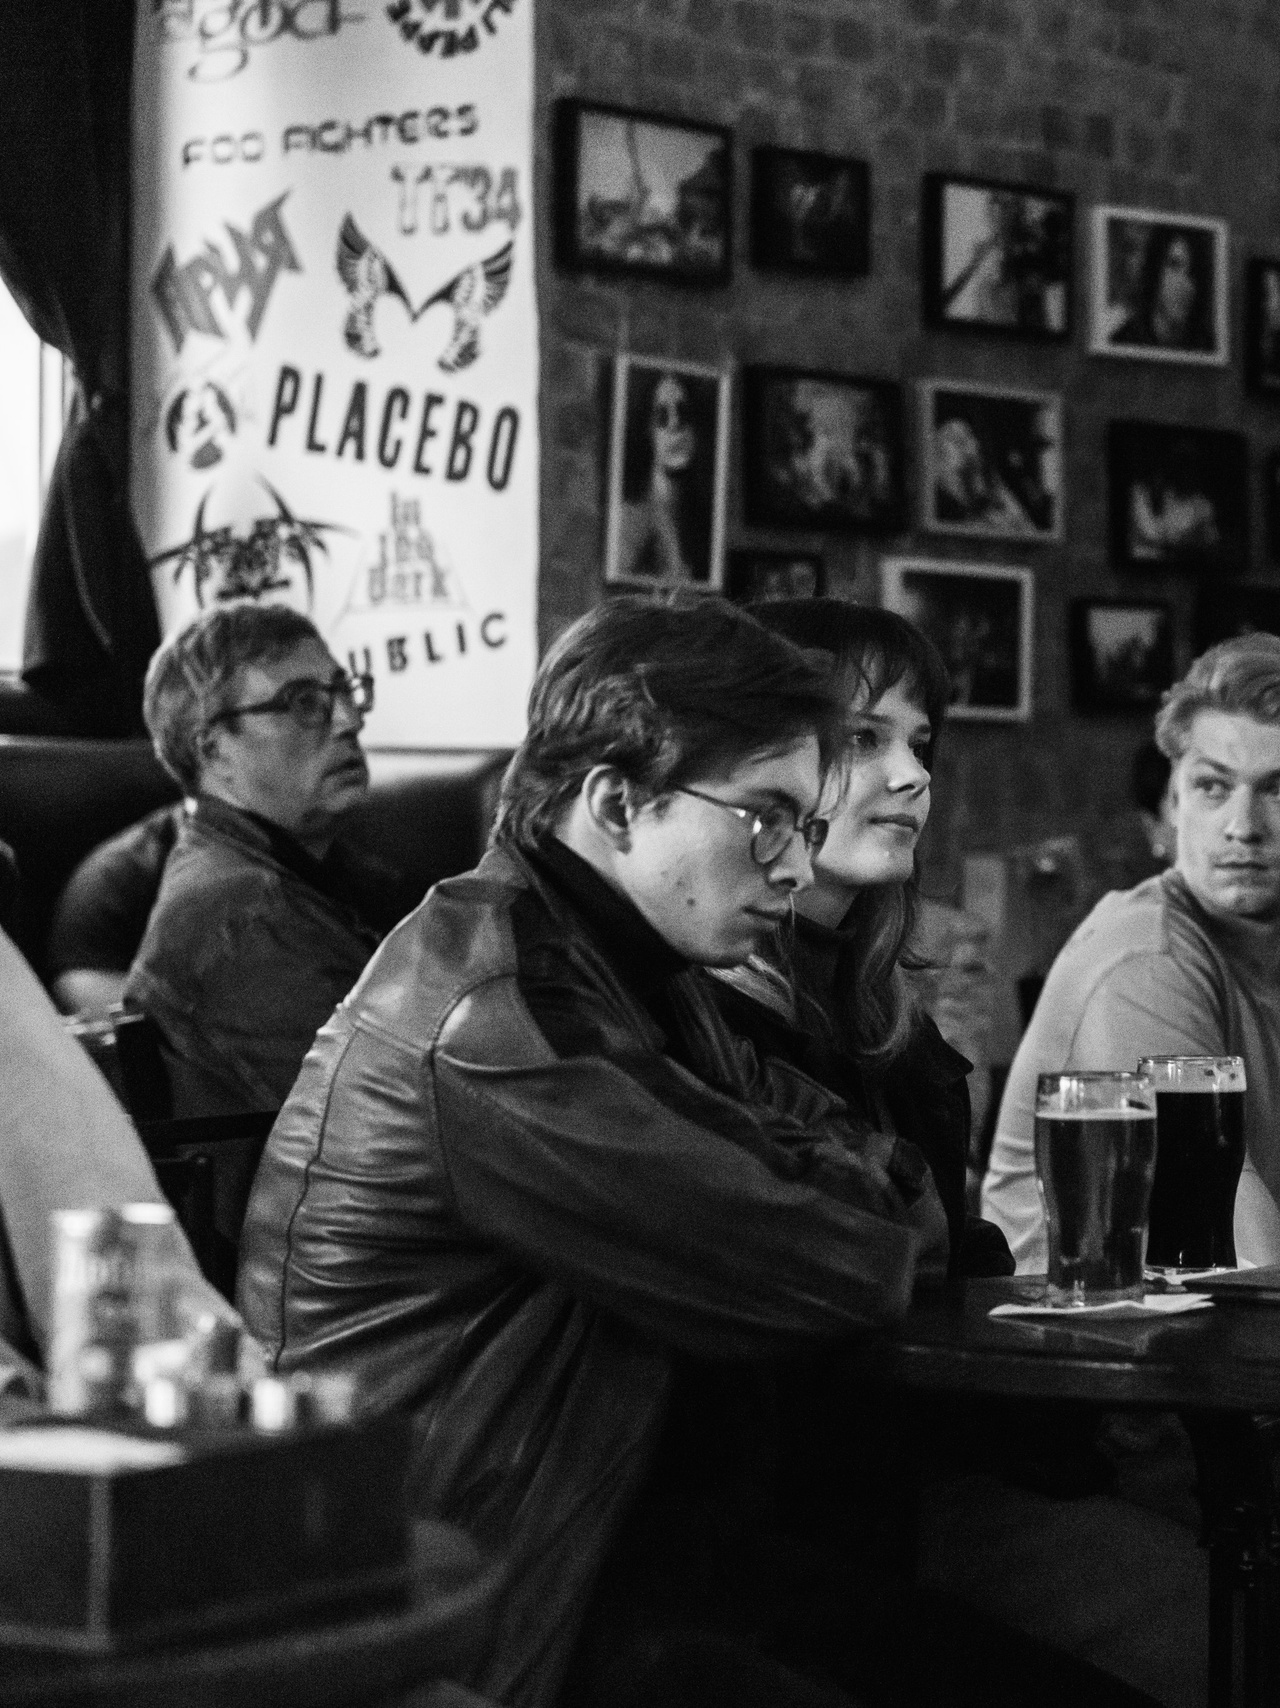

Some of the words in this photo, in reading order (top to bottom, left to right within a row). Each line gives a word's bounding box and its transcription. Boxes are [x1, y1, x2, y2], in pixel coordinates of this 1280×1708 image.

[182, 131, 264, 168] FOO
[282, 103, 479, 153] FIGHTERS
[267, 364, 521, 492] PLACEBO
[347, 611, 508, 678] UBLIC
